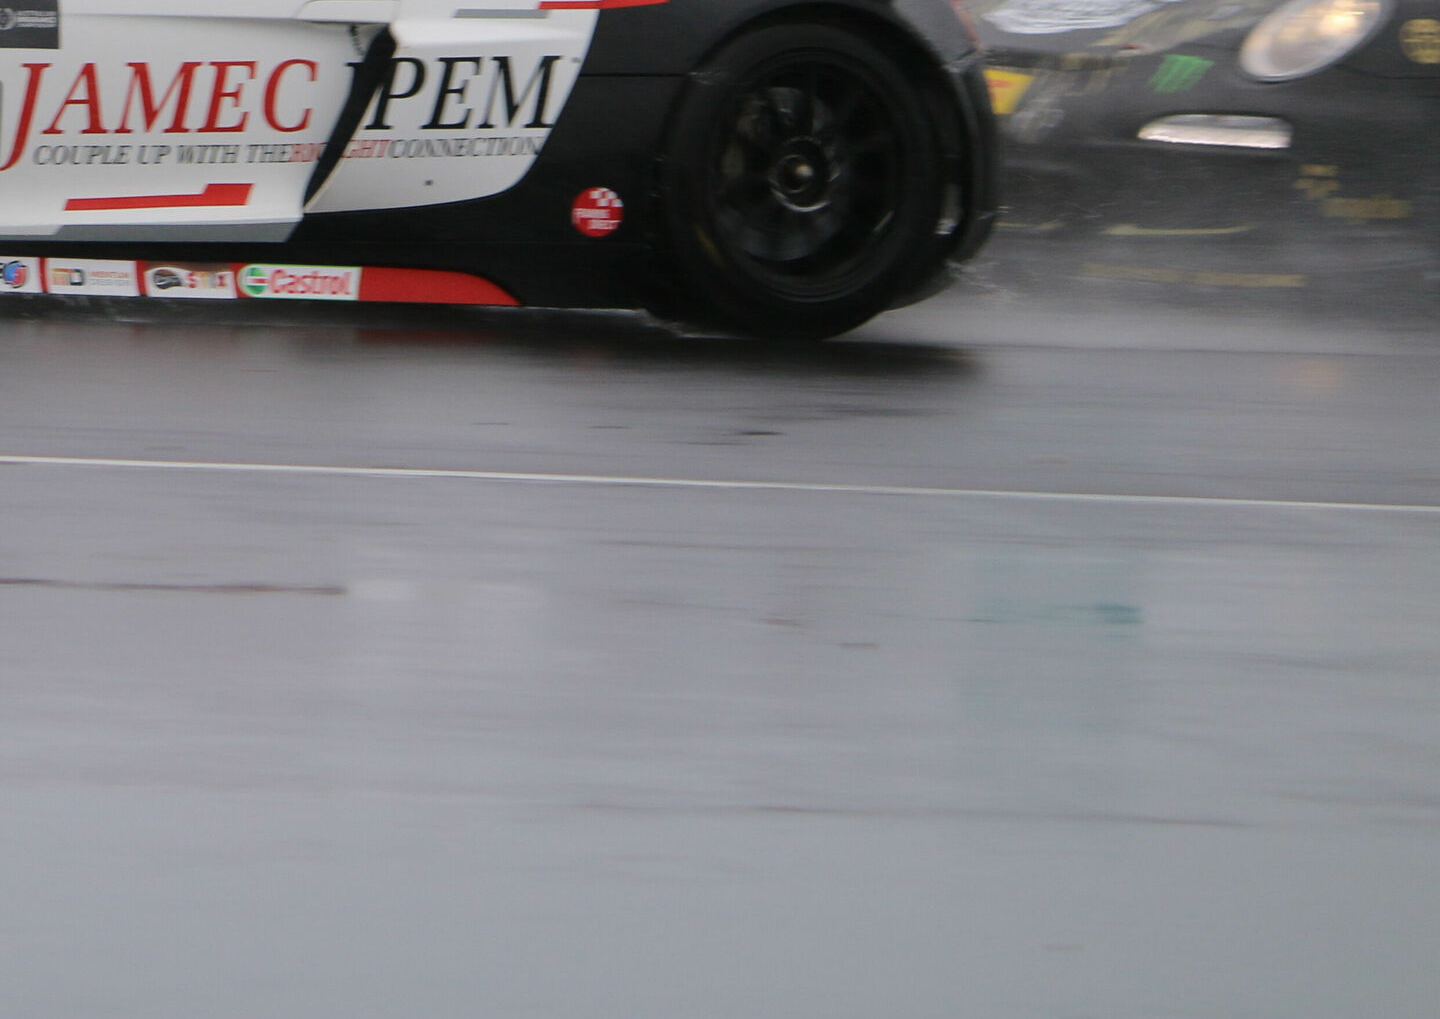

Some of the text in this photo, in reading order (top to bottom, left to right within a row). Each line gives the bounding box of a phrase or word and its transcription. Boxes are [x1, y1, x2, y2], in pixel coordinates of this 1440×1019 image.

[33, 144, 131, 165] COUPLE
[136, 144, 172, 165] UP
[175, 143, 241, 165] WITH
[268, 268, 352, 295] Castrol
